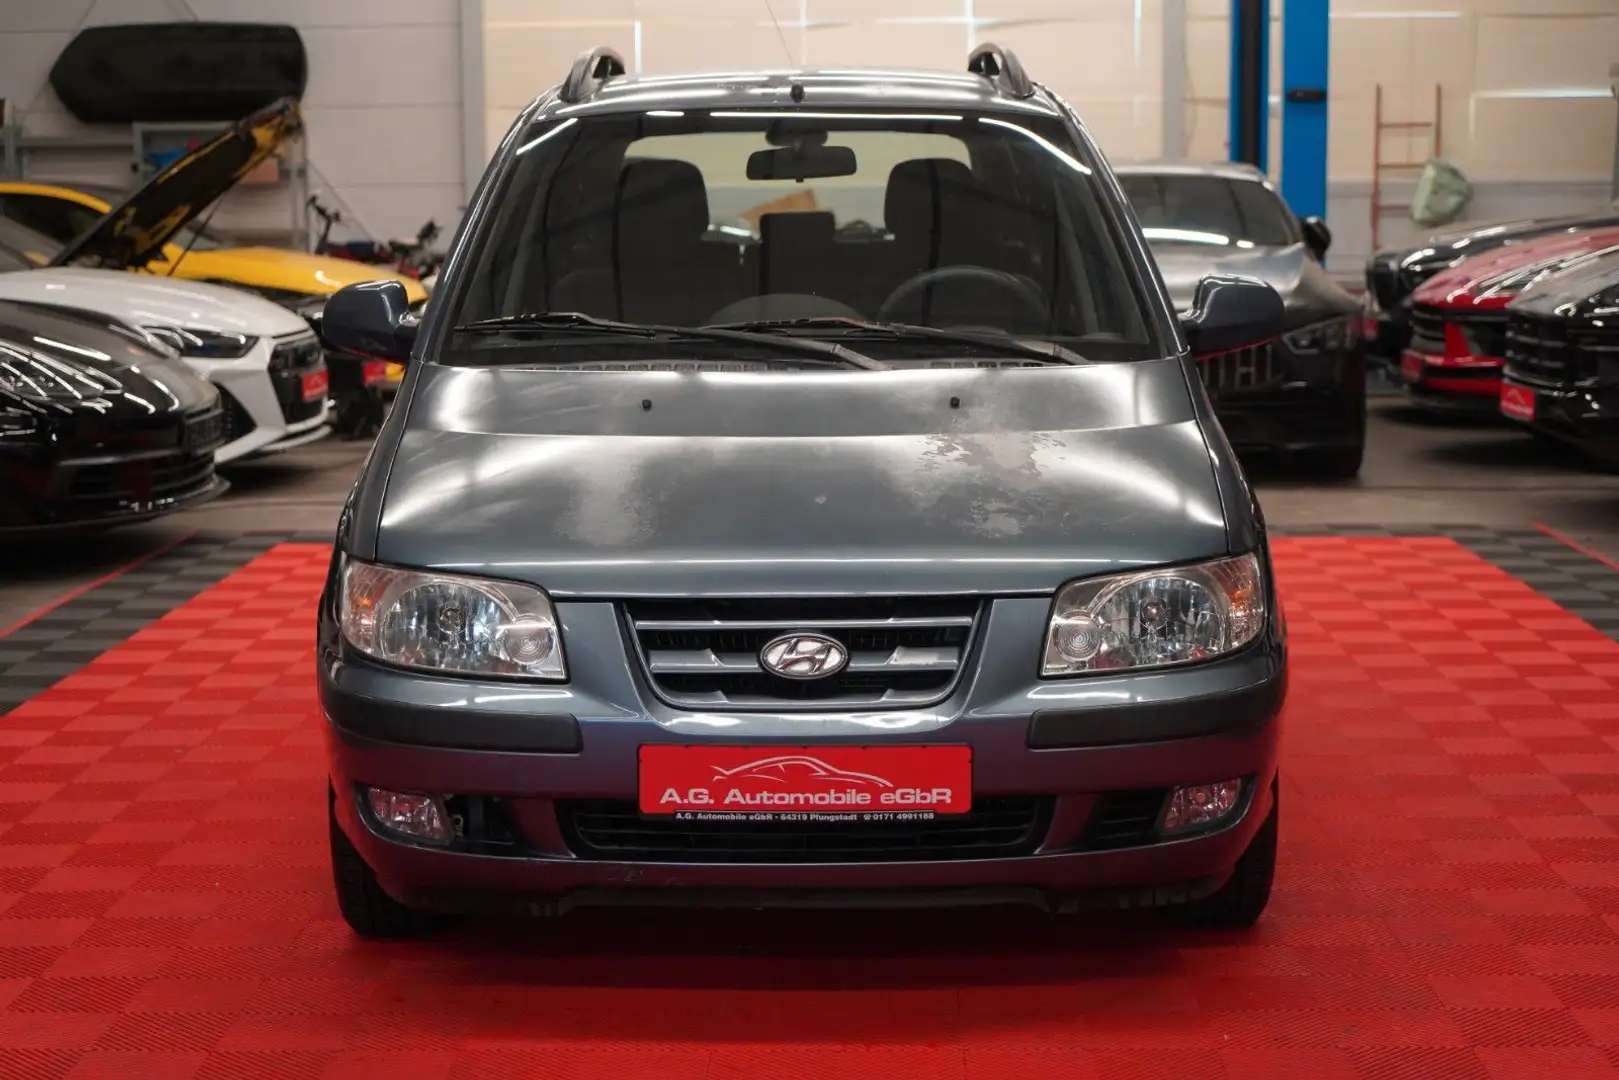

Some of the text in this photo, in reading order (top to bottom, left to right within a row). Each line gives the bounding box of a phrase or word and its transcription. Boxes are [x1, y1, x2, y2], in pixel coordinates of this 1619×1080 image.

[659, 788, 952, 805] A.G. Automobile eGbR
[676, 812, 694, 820] A.G.
[697, 812, 746, 821] Automobile
[749, 813, 773, 821] eGbR
[780, 813, 808, 821] 64319
[810, 813, 857, 822] Pfungstadt
[873, 813, 893, 821] 0171
